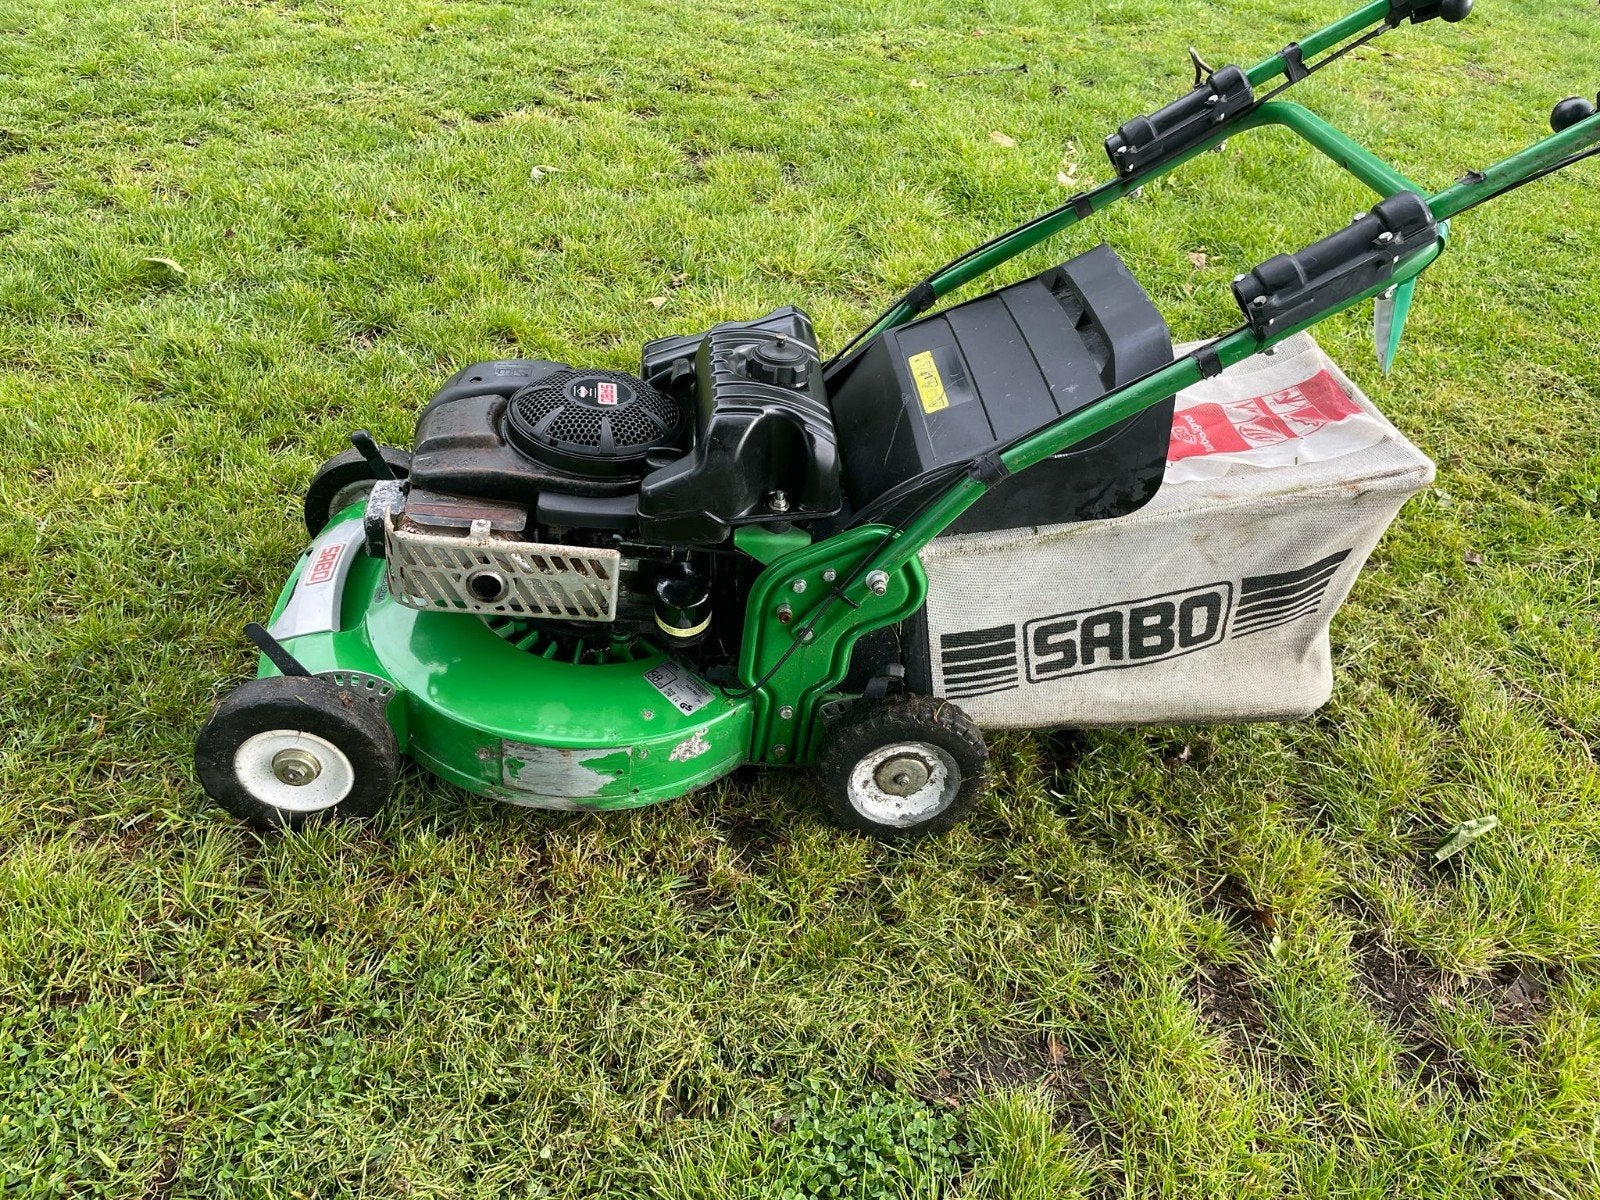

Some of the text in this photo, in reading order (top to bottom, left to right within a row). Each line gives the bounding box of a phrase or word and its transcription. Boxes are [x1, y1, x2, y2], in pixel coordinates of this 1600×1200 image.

[599, 384, 614, 403] SABO
[309, 545, 341, 582] SABO
[1033, 591, 1222, 675] SABO
